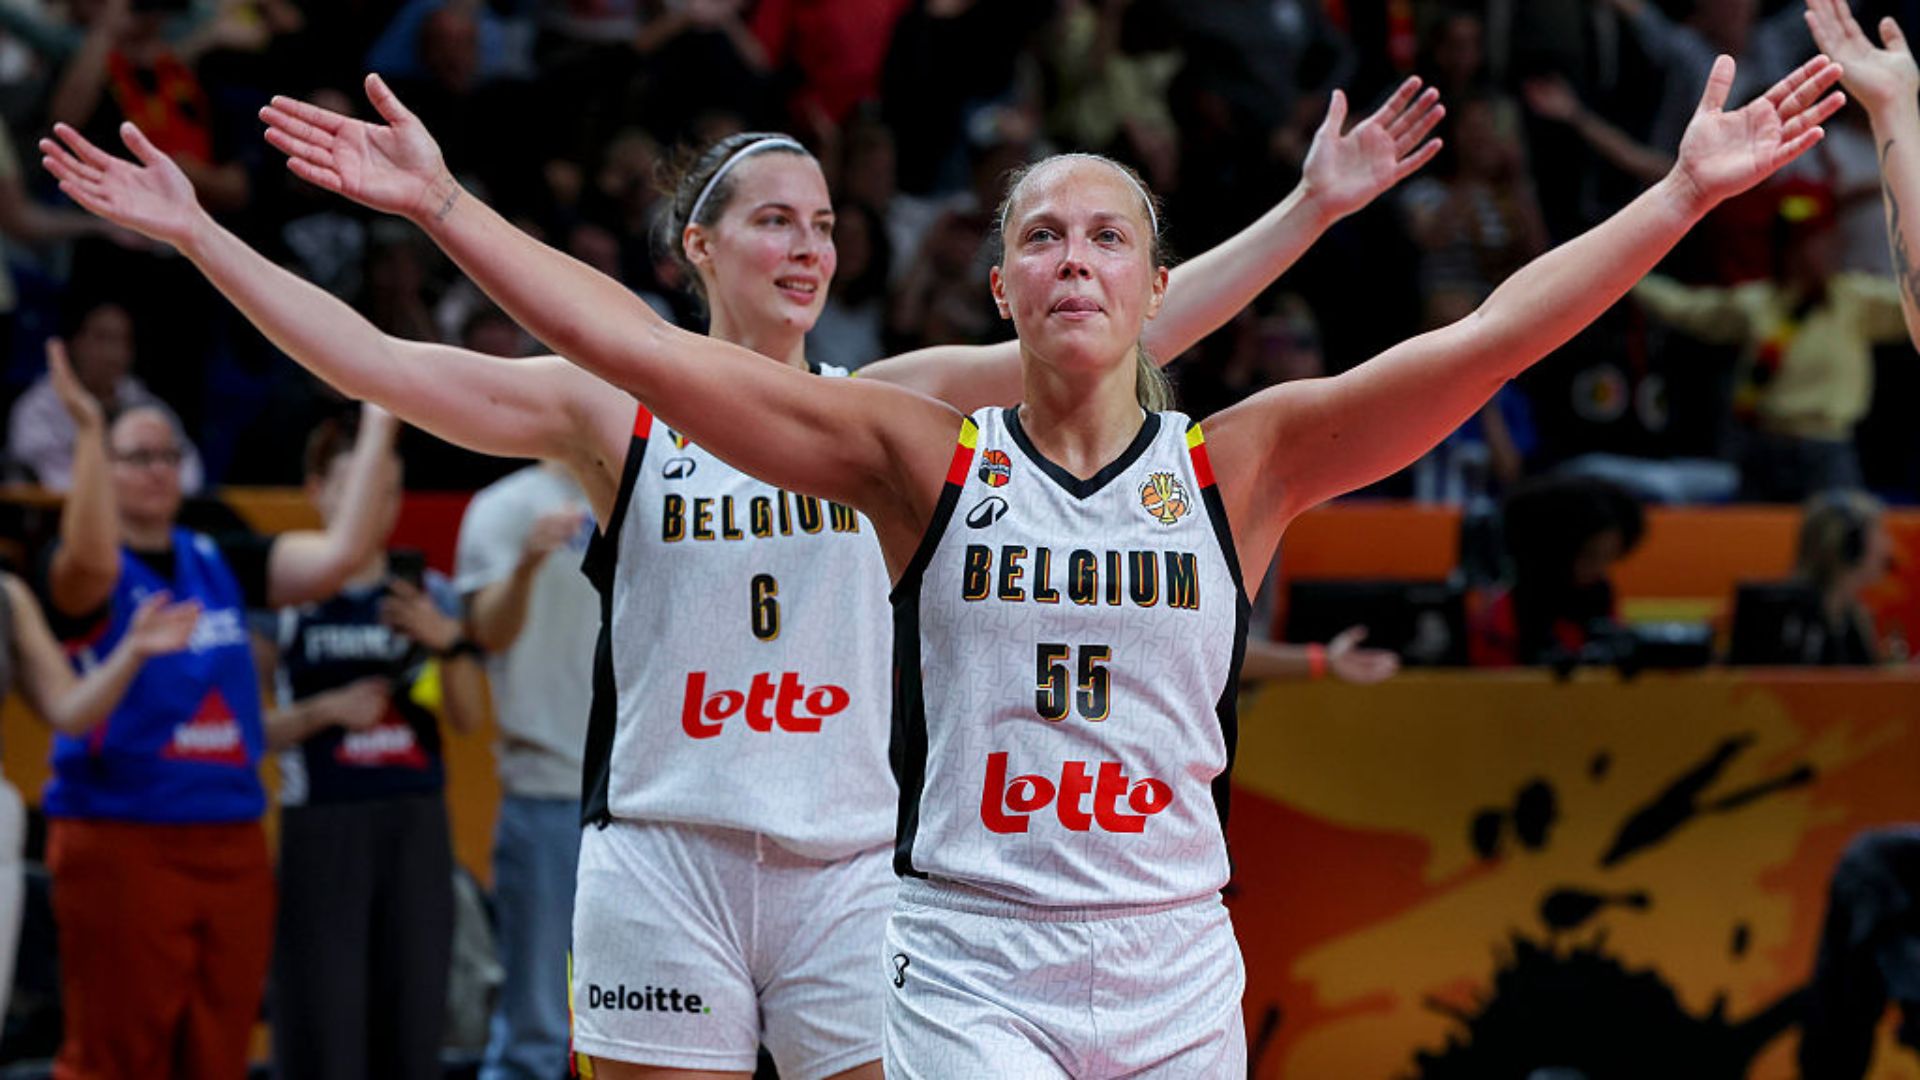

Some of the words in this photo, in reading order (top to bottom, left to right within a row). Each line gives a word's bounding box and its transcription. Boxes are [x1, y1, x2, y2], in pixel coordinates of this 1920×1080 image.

[662, 489, 859, 542] BELGIUM
[751, 573, 780, 641] 6
[962, 544, 1200, 610] BELGIUM
[1035, 643, 1112, 722] 55
[588, 983, 711, 1014] Deloitte.
